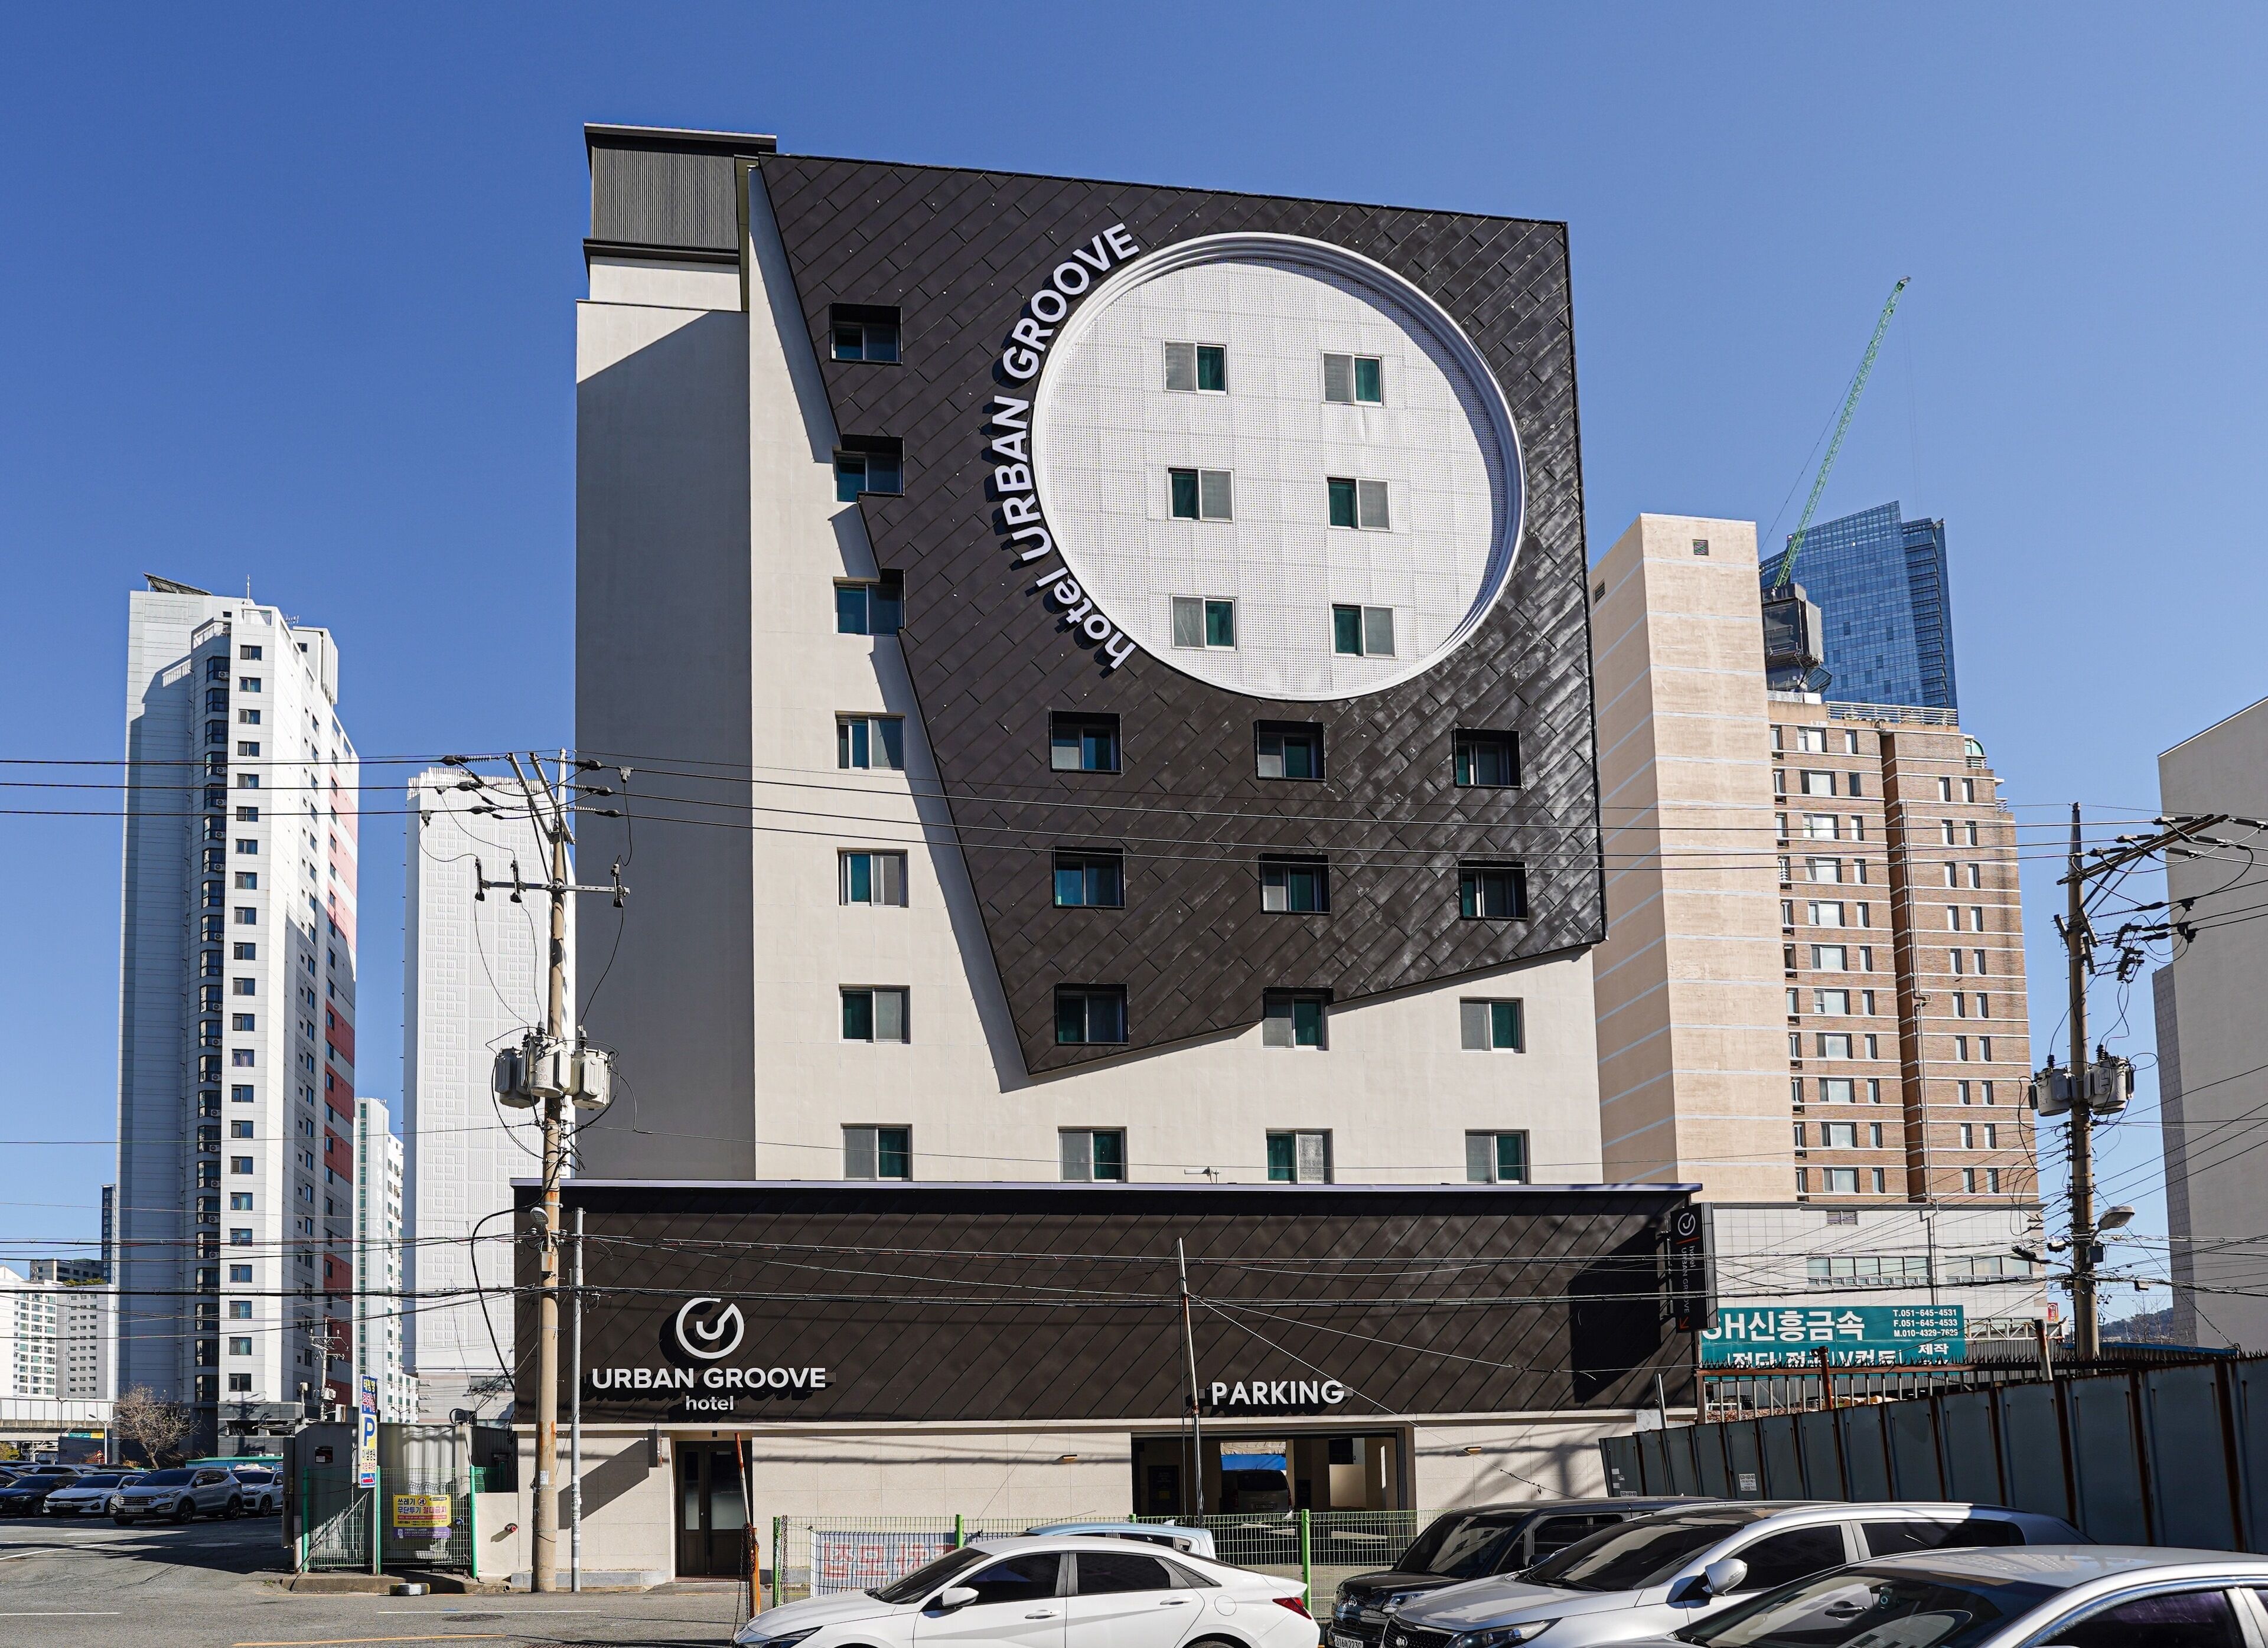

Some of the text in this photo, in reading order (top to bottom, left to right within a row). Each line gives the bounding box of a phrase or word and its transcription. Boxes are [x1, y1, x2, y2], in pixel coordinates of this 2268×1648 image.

[991, 222, 1140, 671] hotel URBAN GROOVE
[1893, 1308, 1957, 1317] T.051-645-4531
[1894, 1319, 1958, 1327] F.051-645-4533
[1918, 1343, 1949, 1355] 제작
[592, 1368, 826, 1389] URBAN GROOVE
[1211, 1380, 1345, 1405] PARKING
[686, 1395, 734, 1411] hotel
[364, 1417, 375, 1447] P
